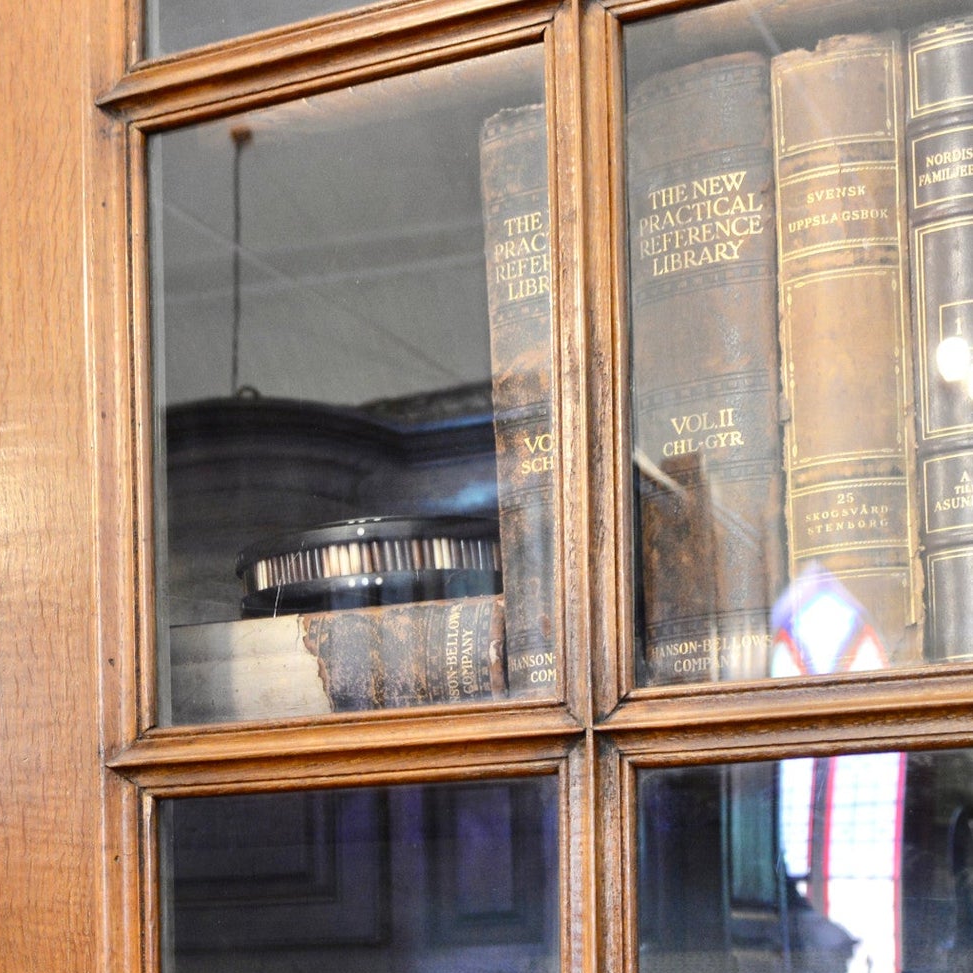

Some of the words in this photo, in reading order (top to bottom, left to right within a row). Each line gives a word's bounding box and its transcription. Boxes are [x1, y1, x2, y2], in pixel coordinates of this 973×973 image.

[925, 148, 973, 168] NORDIS
[648, 184, 688, 210] THE
[690, 171, 747, 198] NEW
[806, 185, 866, 204] SVENSK
[504, 212, 543, 237] THE
[639, 193, 763, 237] PRACTICAL
[788, 208, 889, 233] UPPSLAGSBOK
[494, 232, 550, 263] PRAC
[639, 215, 763, 260] REFERENCE
[652, 240, 744, 277] LIBRARY
[671, 408, 735, 435] VOL.II
[663, 430, 744, 457] CHL-GYR
[959, 470, 971, 482] A
[837, 492, 855, 505] 25
[805, 504, 889, 522] SKOGSVÅRD
[807, 519, 889, 536] STENBORG
[651, 634, 773, 659] HANSON-BELLOWS
[460, 628, 474, 695] COMPANY
[530, 668, 557, 683] COM
